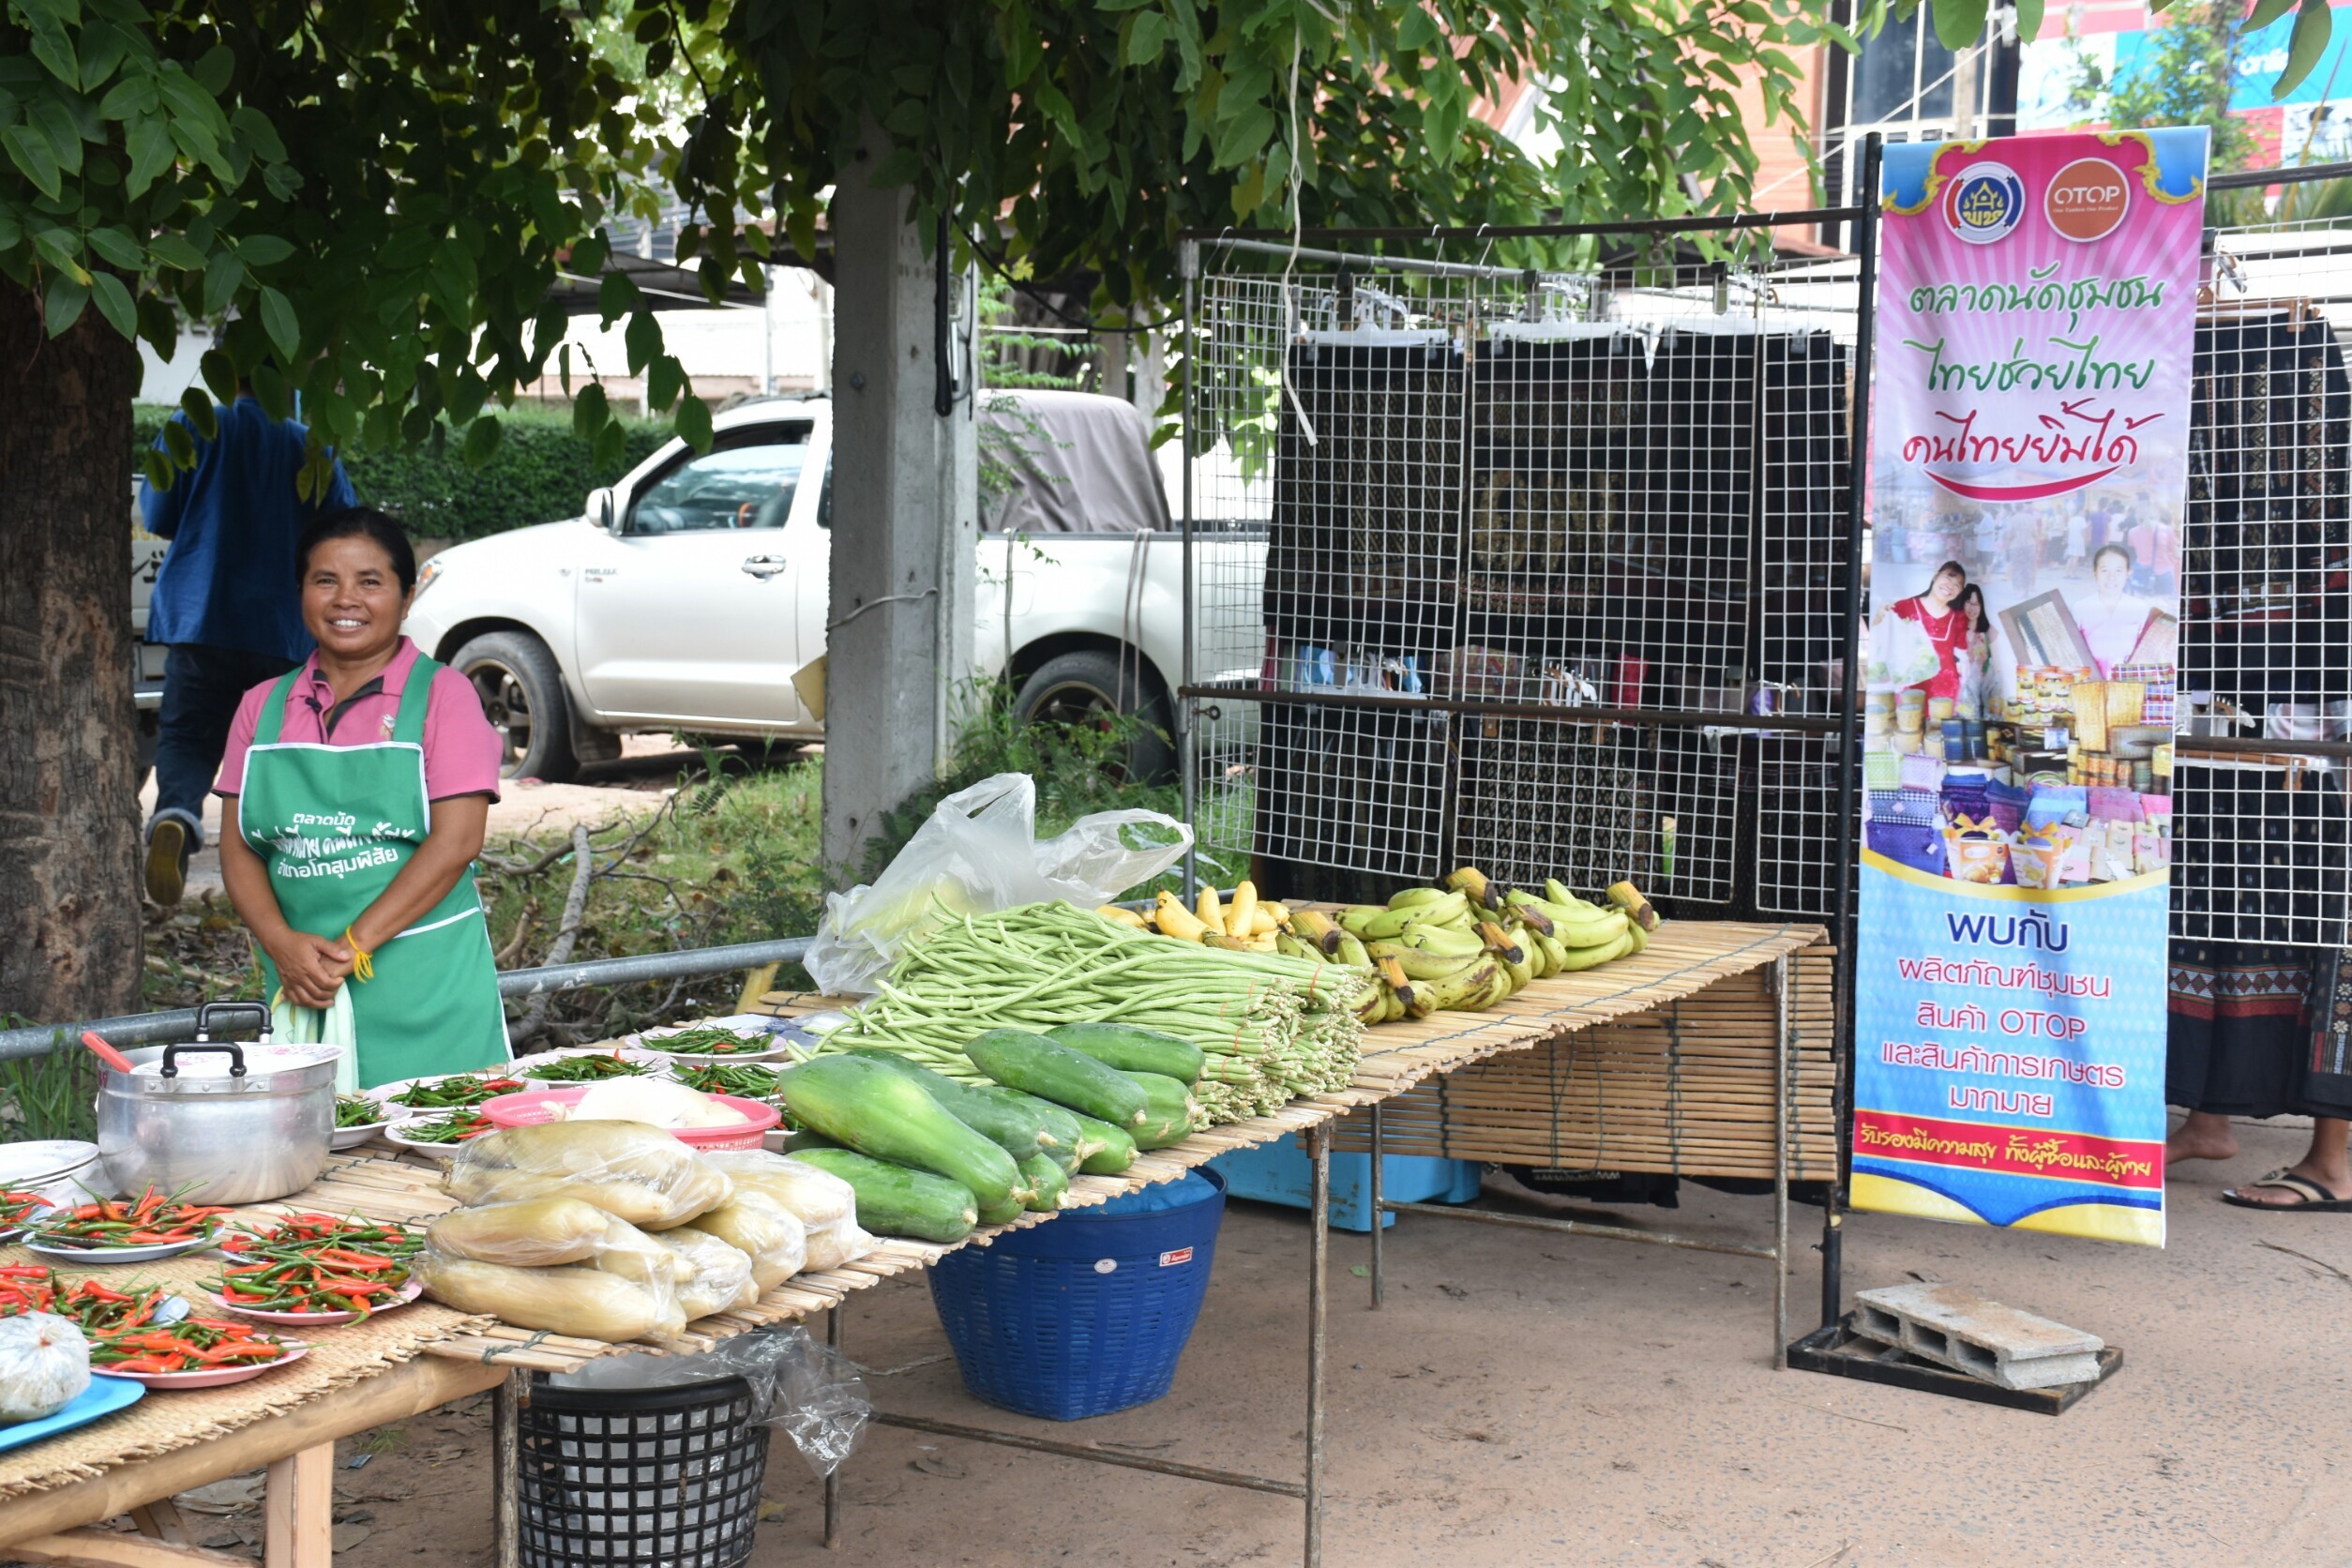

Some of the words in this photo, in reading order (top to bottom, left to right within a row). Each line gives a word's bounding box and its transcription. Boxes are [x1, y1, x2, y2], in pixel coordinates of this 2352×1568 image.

[2054, 186, 2120, 204] OTOP
[1909, 263, 2163, 333] ตลาดนัดชุมชน
[1903, 336, 2155, 391] ไทยช่วยไทย
[1903, 398, 2164, 464] คนไทยยิ้มได้
[293, 811, 356, 826] ตลาดนัด
[1947, 908, 2068, 952] พบกับ
[1898, 956, 2111, 1000] ผลิตภัณฑ์ชุมชน
[1917, 1002, 1986, 1031] สินค้า
[1999, 1010, 2087, 1040] OTOP
[1882, 1041, 2124, 1088] และสินค้าการเกษตร
[1950, 1085, 2052, 1116] มากมาย
[1861, 1123, 1998, 1165] รับรองมีความสุข
[2004, 1134, 2152, 1180] ทั้งผู้ซื้อและผู้ขาย
